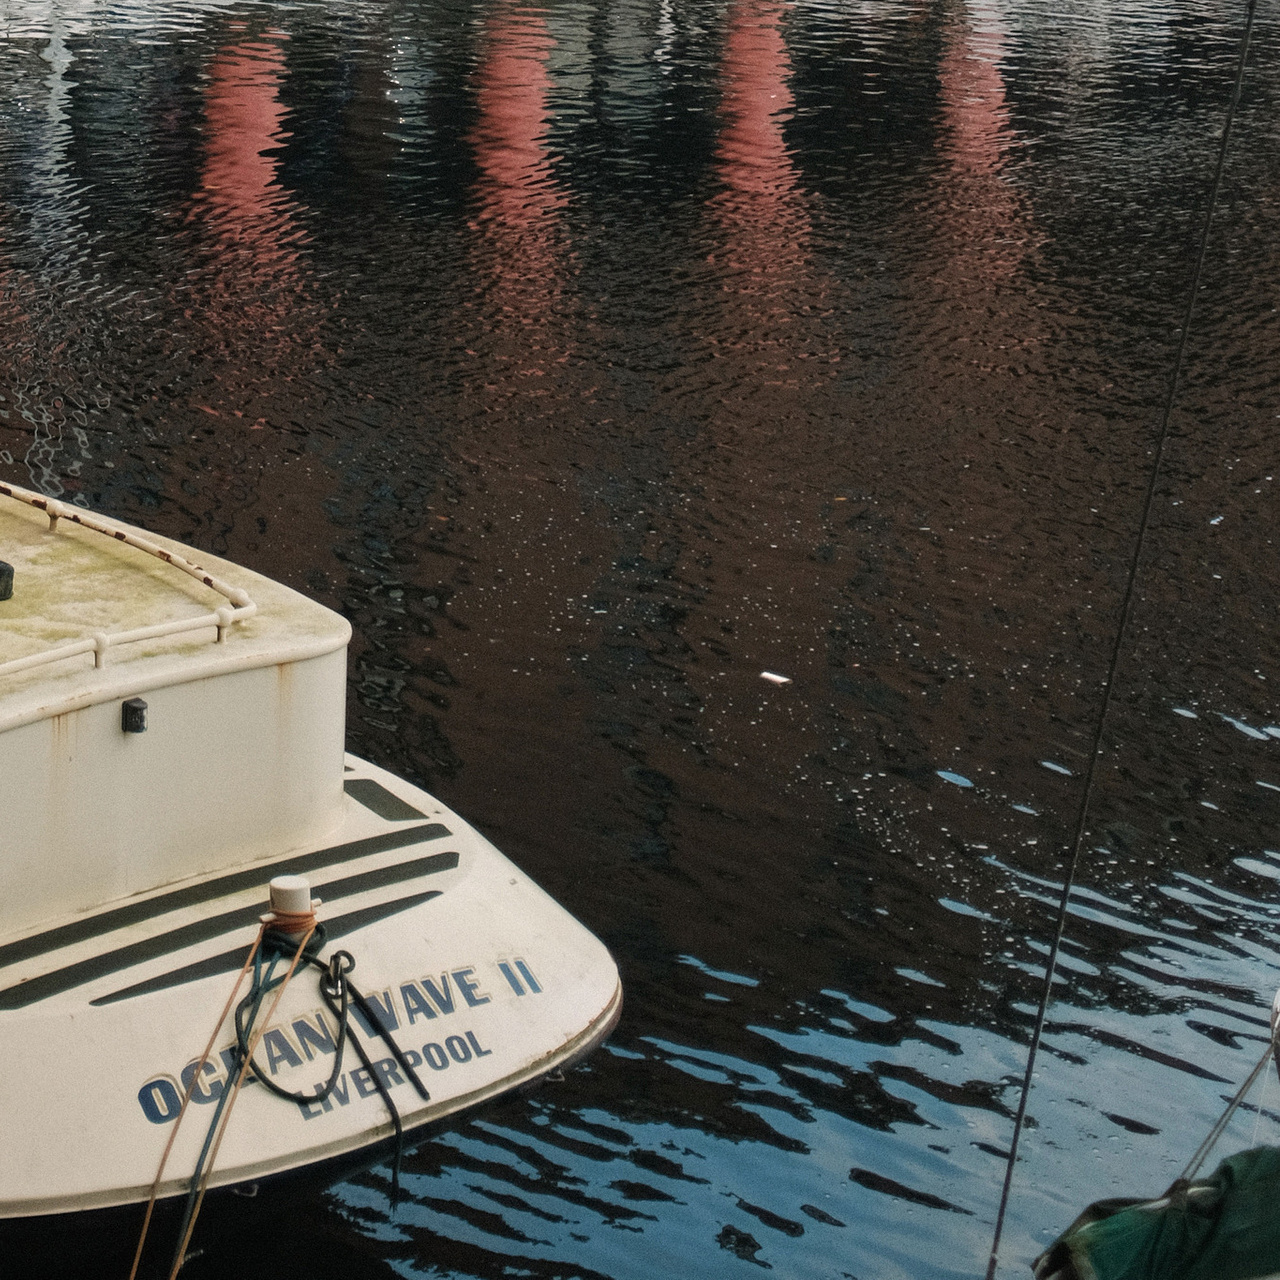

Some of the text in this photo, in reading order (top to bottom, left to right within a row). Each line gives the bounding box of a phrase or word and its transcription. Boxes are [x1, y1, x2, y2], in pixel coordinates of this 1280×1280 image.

[349, 968, 491, 1039] WAVE
[498, 959, 542, 997] II
[295, 1030, 492, 1122] LIVERPOOL
